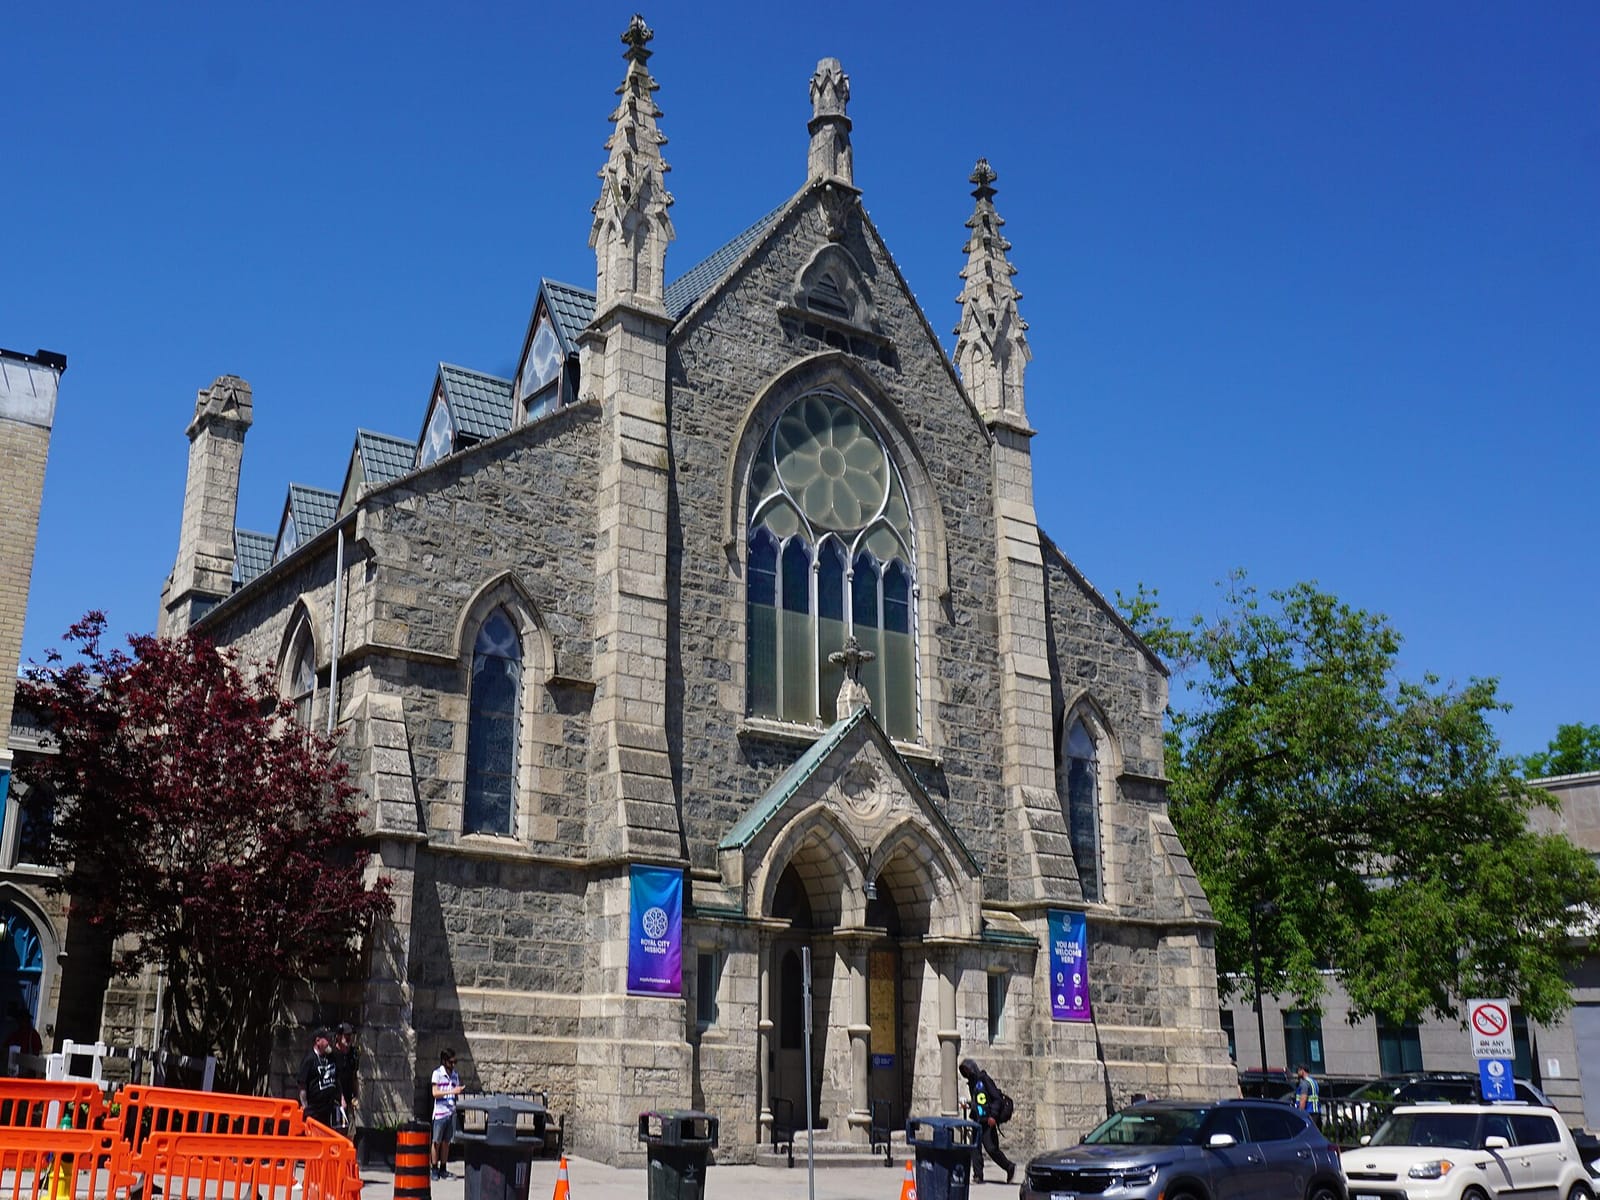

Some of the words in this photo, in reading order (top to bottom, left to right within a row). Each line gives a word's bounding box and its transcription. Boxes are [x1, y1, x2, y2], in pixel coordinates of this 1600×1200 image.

[640, 938, 656, 946] ROYAL
[657, 939, 670, 948] CITY
[1056, 940, 1067, 948] YOU
[1068, 942, 1079, 950] ARE
[644, 945, 666, 954] MISSION
[1055, 948, 1082, 957] WELCOME
[1477, 1047, 1512, 1055] SIDEWALKS
